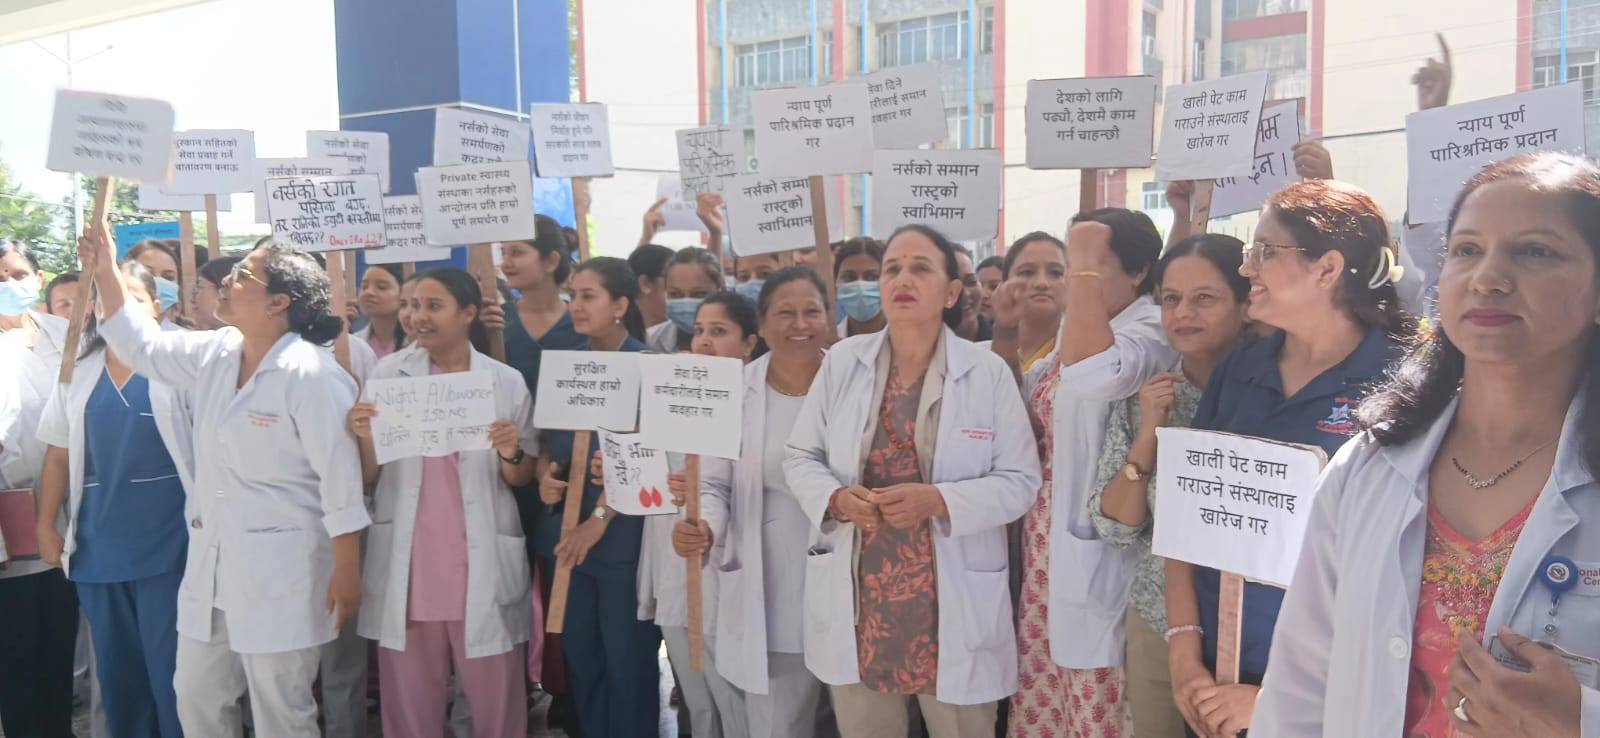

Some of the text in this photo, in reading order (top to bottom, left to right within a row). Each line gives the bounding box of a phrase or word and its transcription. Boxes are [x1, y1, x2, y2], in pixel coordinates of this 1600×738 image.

[786, 94, 833, 113] न्याय पूर्ण
[1056, 88, 1123, 104] देशको लागि
[1182, 89, 1248, 109] खाली पेट काम
[899, 107, 912, 119] गर
[1110, 109, 1137, 121] काम
[1174, 113, 1206, 130] गराउने
[1456, 104, 1526, 132] न्याय पूर्ण
[459, 120, 510, 138] नर्सको सेवा
[769, 116, 855, 132] पारिश्रमिक प्रदान
[1056, 126, 1075, 141] गर्न
[1186, 133, 1230, 150] खारेज गर
[460, 137, 505, 154] समर्पणको
[805, 137, 821, 149] गर
[1430, 128, 1558, 162] पारिश्रमिक प्रदान
[892, 159, 980, 177] नर्सको सम्मान
[440, 172, 478, 183] Private
[272, 179, 356, 201] नर्सको रगत
[742, 177, 809, 197] नर्सको सम्मा
[902, 202, 966, 220] स्वाभिमान
[451, 215, 467, 229] पूर्ण
[500, 215, 510, 225] छ
[757, 215, 813, 233] स्वाभिमान
[574, 361, 608, 376] सुरक्षित
[374, 383, 418, 412] Night
[567, 394, 606, 407] अधिकार
[1186, 448, 1288, 480] खाली पेट काम
[1176, 476, 1298, 514] गराउने संस्थालाइ
[1199, 504, 1269, 536] खारेज गर
